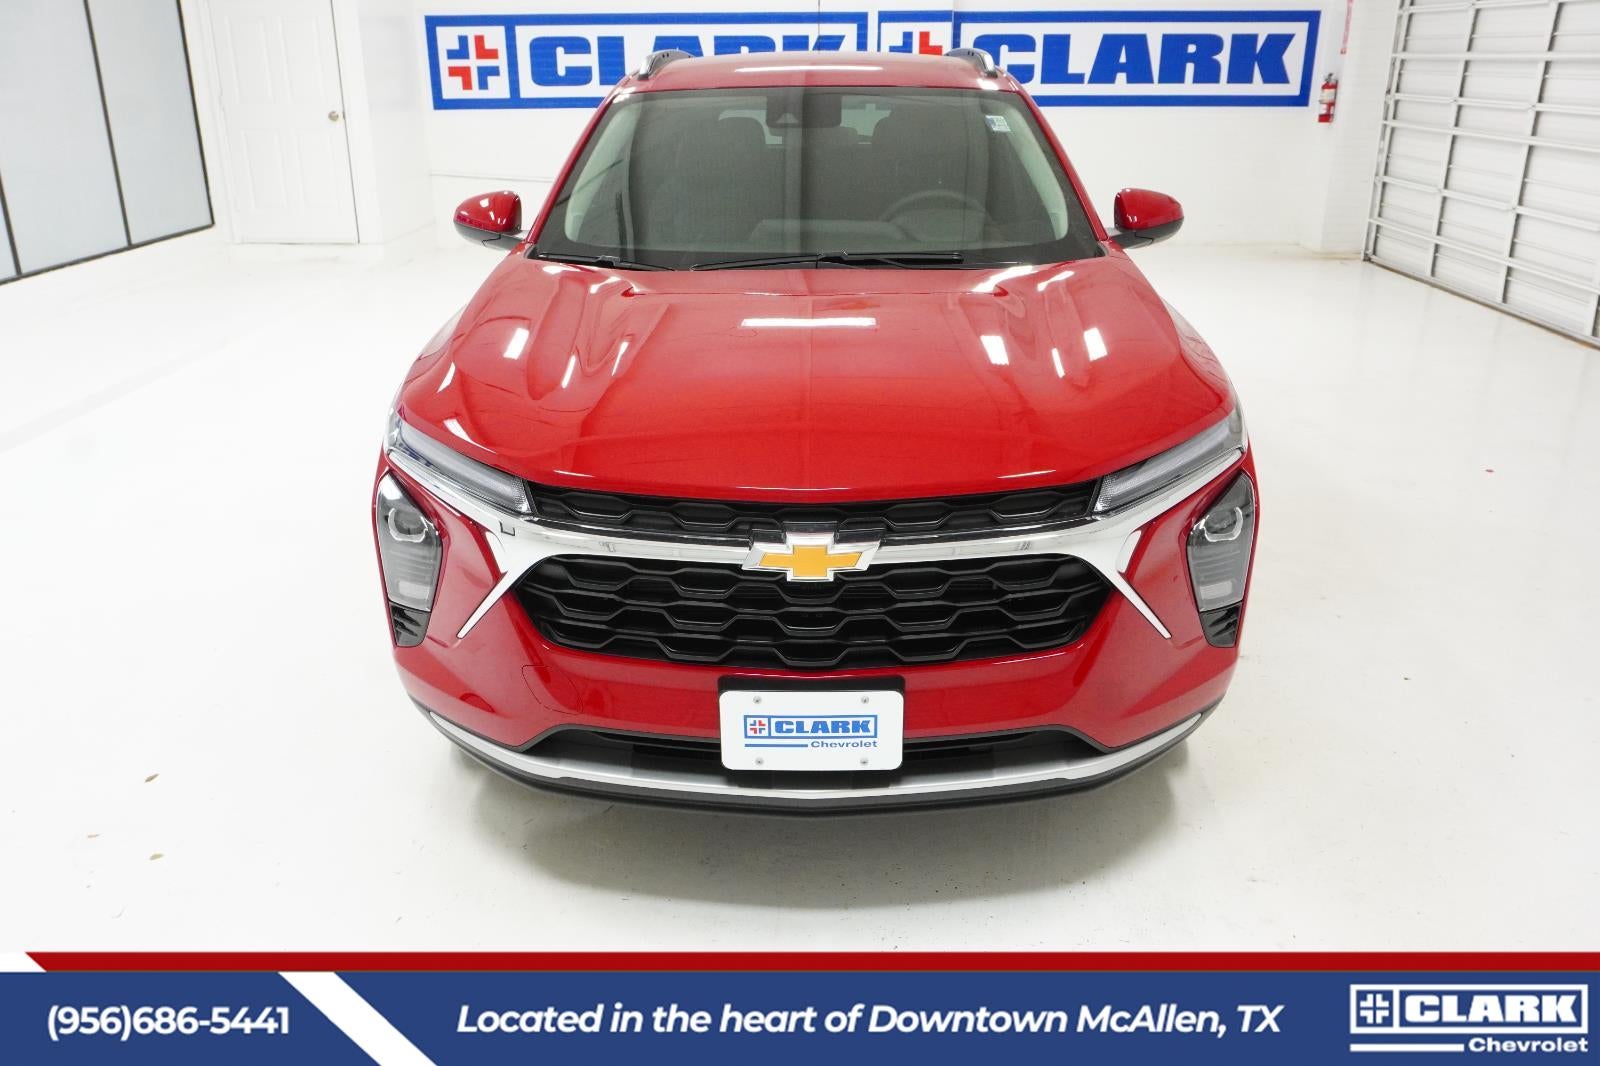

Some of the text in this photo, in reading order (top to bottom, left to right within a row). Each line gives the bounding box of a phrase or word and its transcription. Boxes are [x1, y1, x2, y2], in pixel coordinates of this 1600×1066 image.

[973, 33, 1295, 85] CLARK
[775, 720, 870, 734] CLARK
[811, 740, 878, 748] Chevrolet
